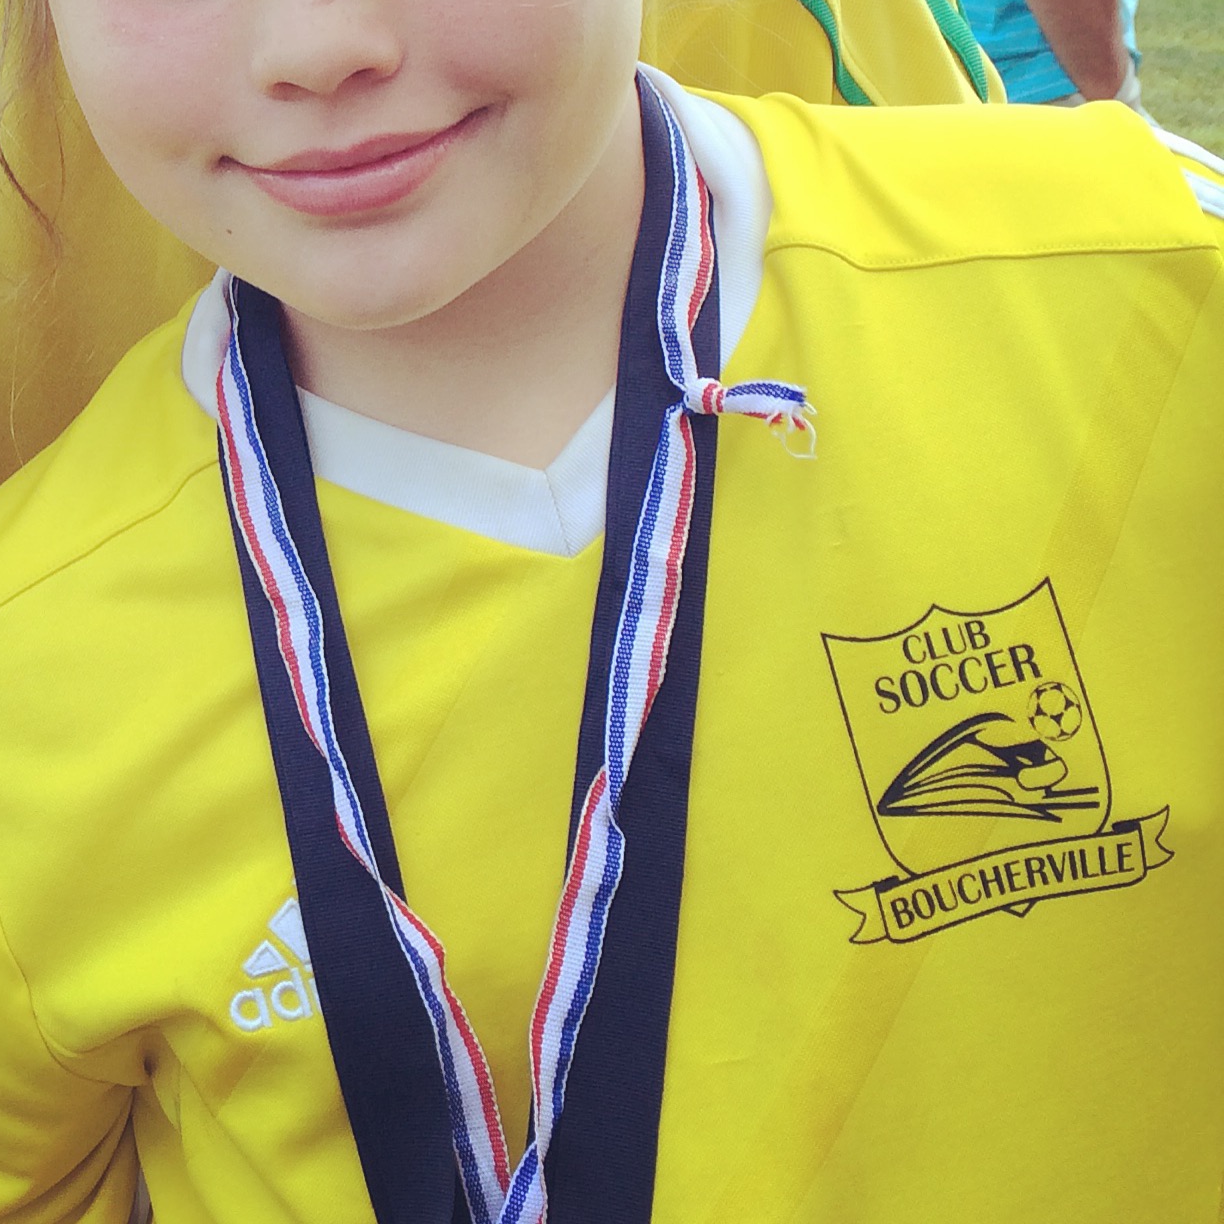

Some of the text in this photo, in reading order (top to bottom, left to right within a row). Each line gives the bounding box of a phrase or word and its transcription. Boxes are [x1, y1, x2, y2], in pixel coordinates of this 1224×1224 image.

[902, 619, 991, 665] CLUB
[874, 643, 1043, 714] SOCCER
[889, 841, 1136, 930] BOUCHERVILLE
